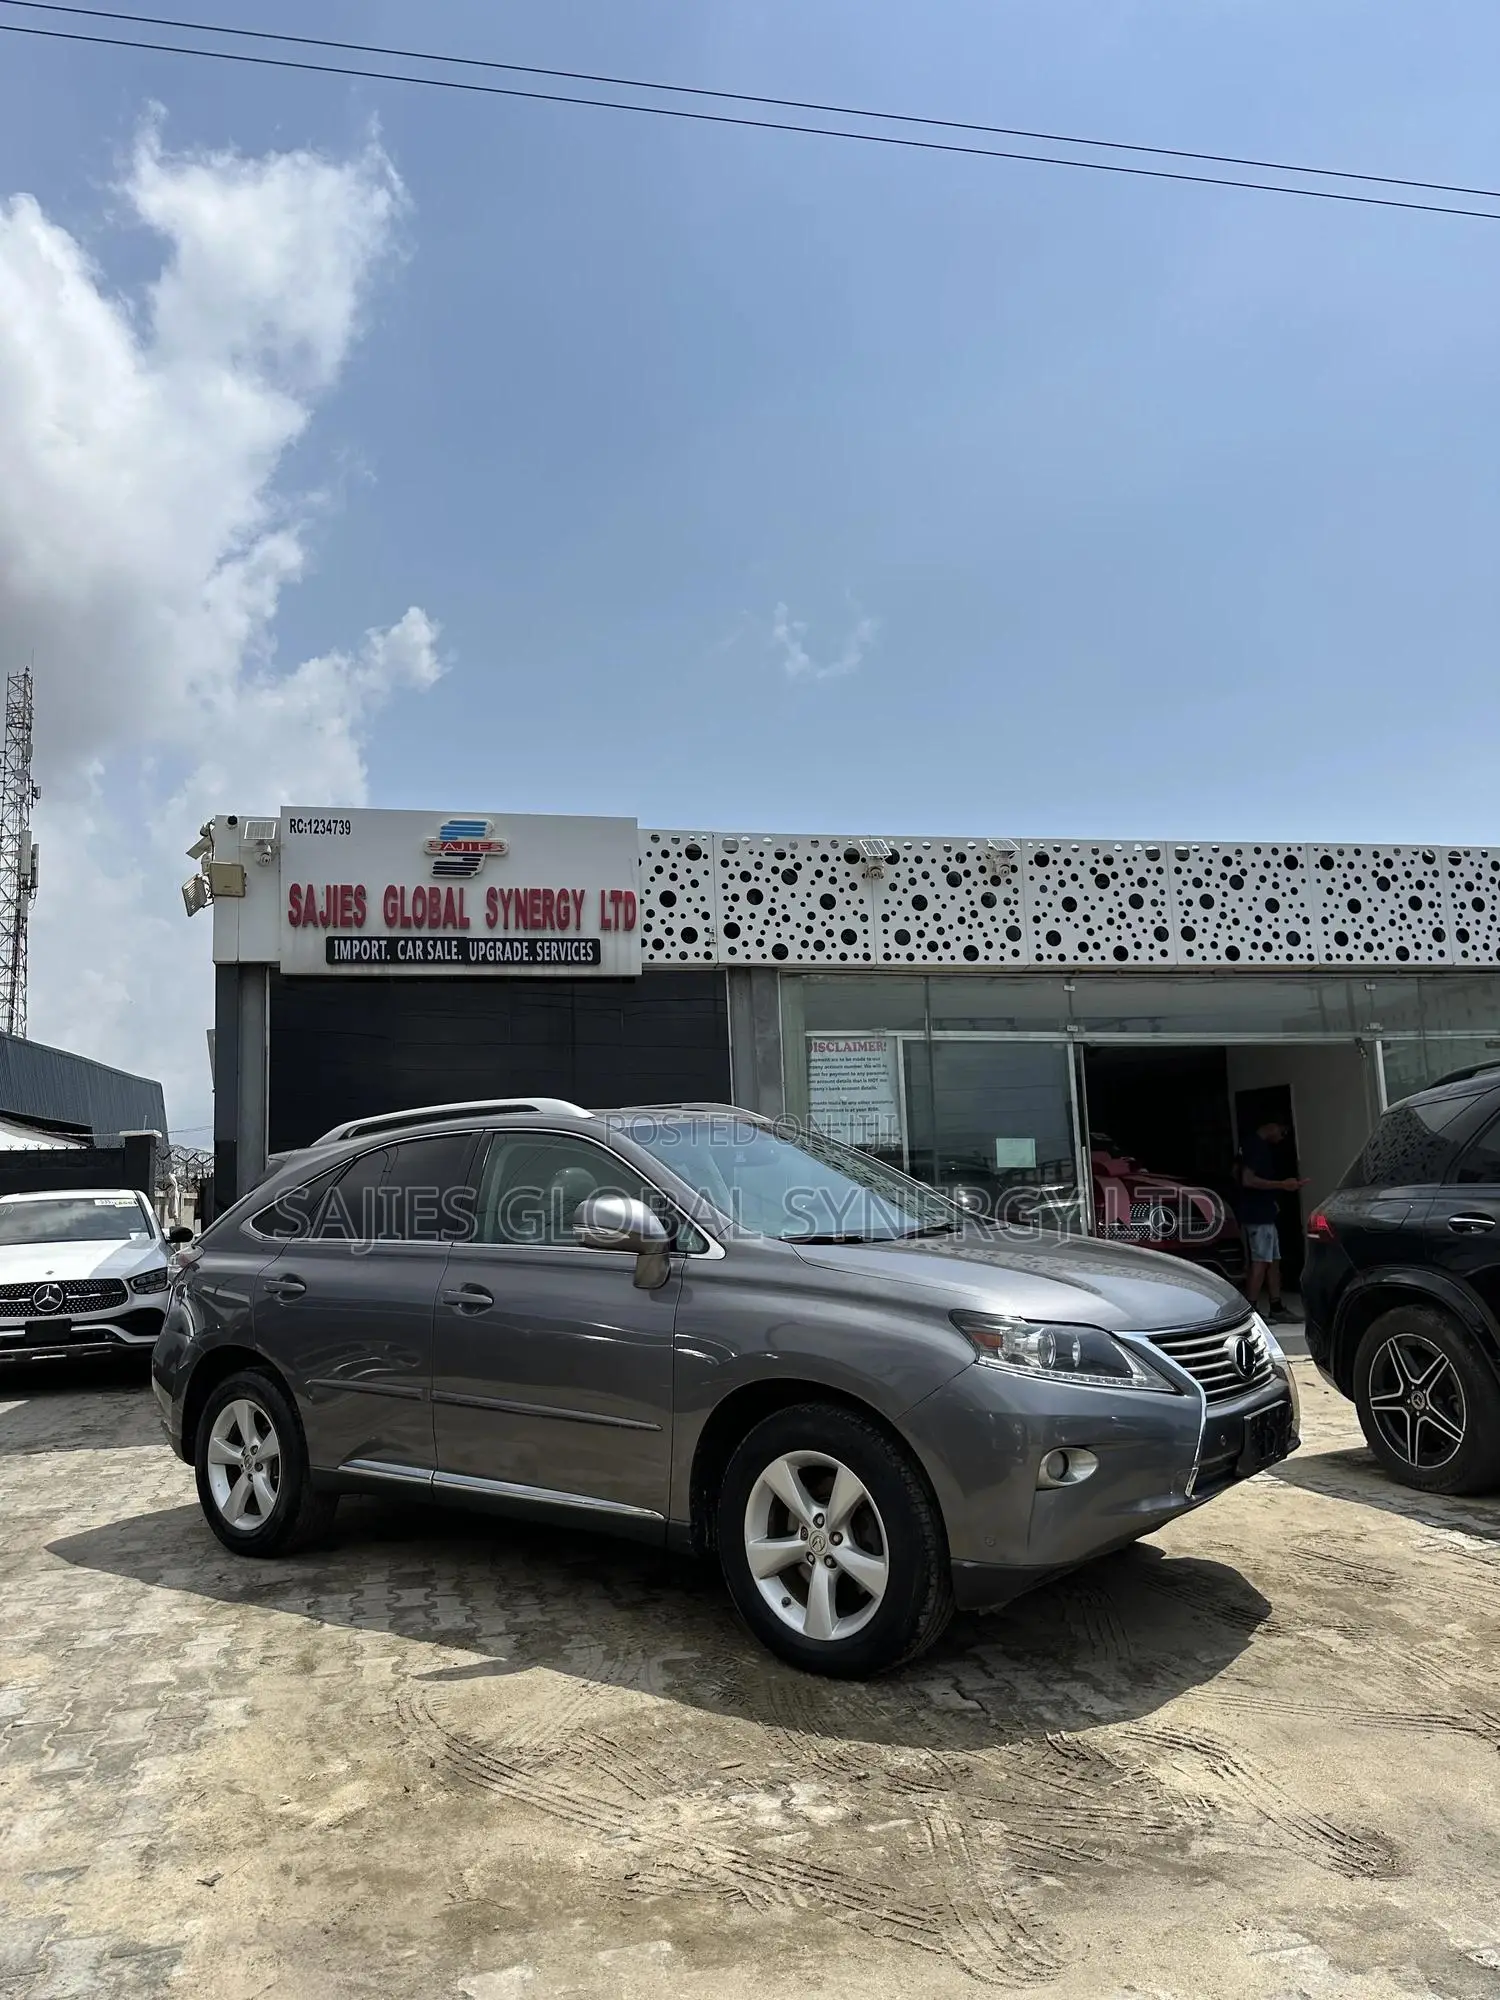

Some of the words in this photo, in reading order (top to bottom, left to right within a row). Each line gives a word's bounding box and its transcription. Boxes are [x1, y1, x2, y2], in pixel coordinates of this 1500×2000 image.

[289, 818, 351, 836] RC:1234739
[429, 842, 502, 852] SAJIES
[287, 882, 367, 929] SAJIES
[383, 885, 470, 930] GLOBAL
[485, 886, 586, 931] SYNERGY
[599, 889, 637, 932] LTD
[334, 940, 390, 960] IMPORT.
[397, 941, 424, 960] CAR
[427, 941, 462, 961] SALE.
[469, 941, 533, 962] UPGRADE.
[536, 942, 594, 962] SERVICES
